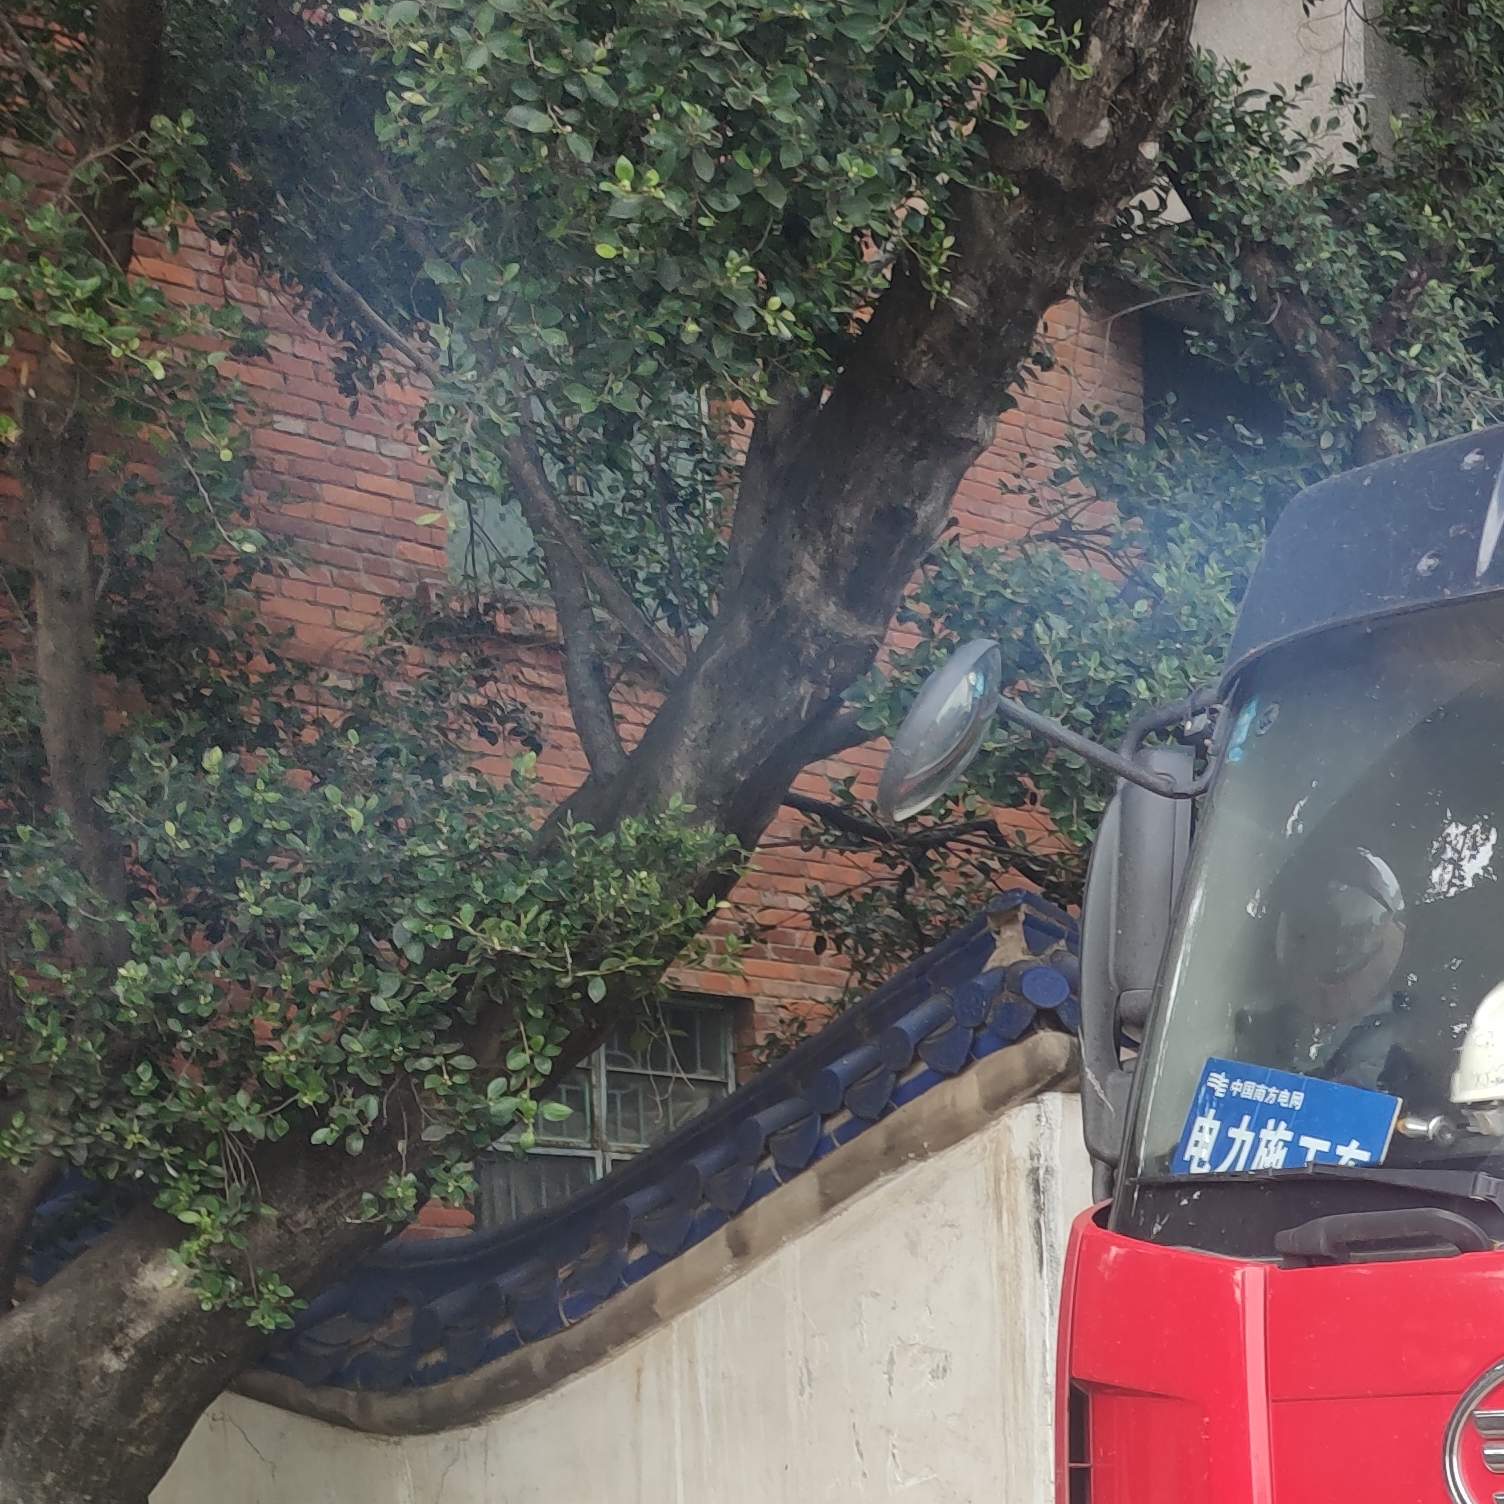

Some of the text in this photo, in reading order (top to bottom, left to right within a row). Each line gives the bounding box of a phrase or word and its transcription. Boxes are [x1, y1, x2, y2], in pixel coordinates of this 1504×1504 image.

[1230, 1079, 1305, 1111] 中国南方电网
